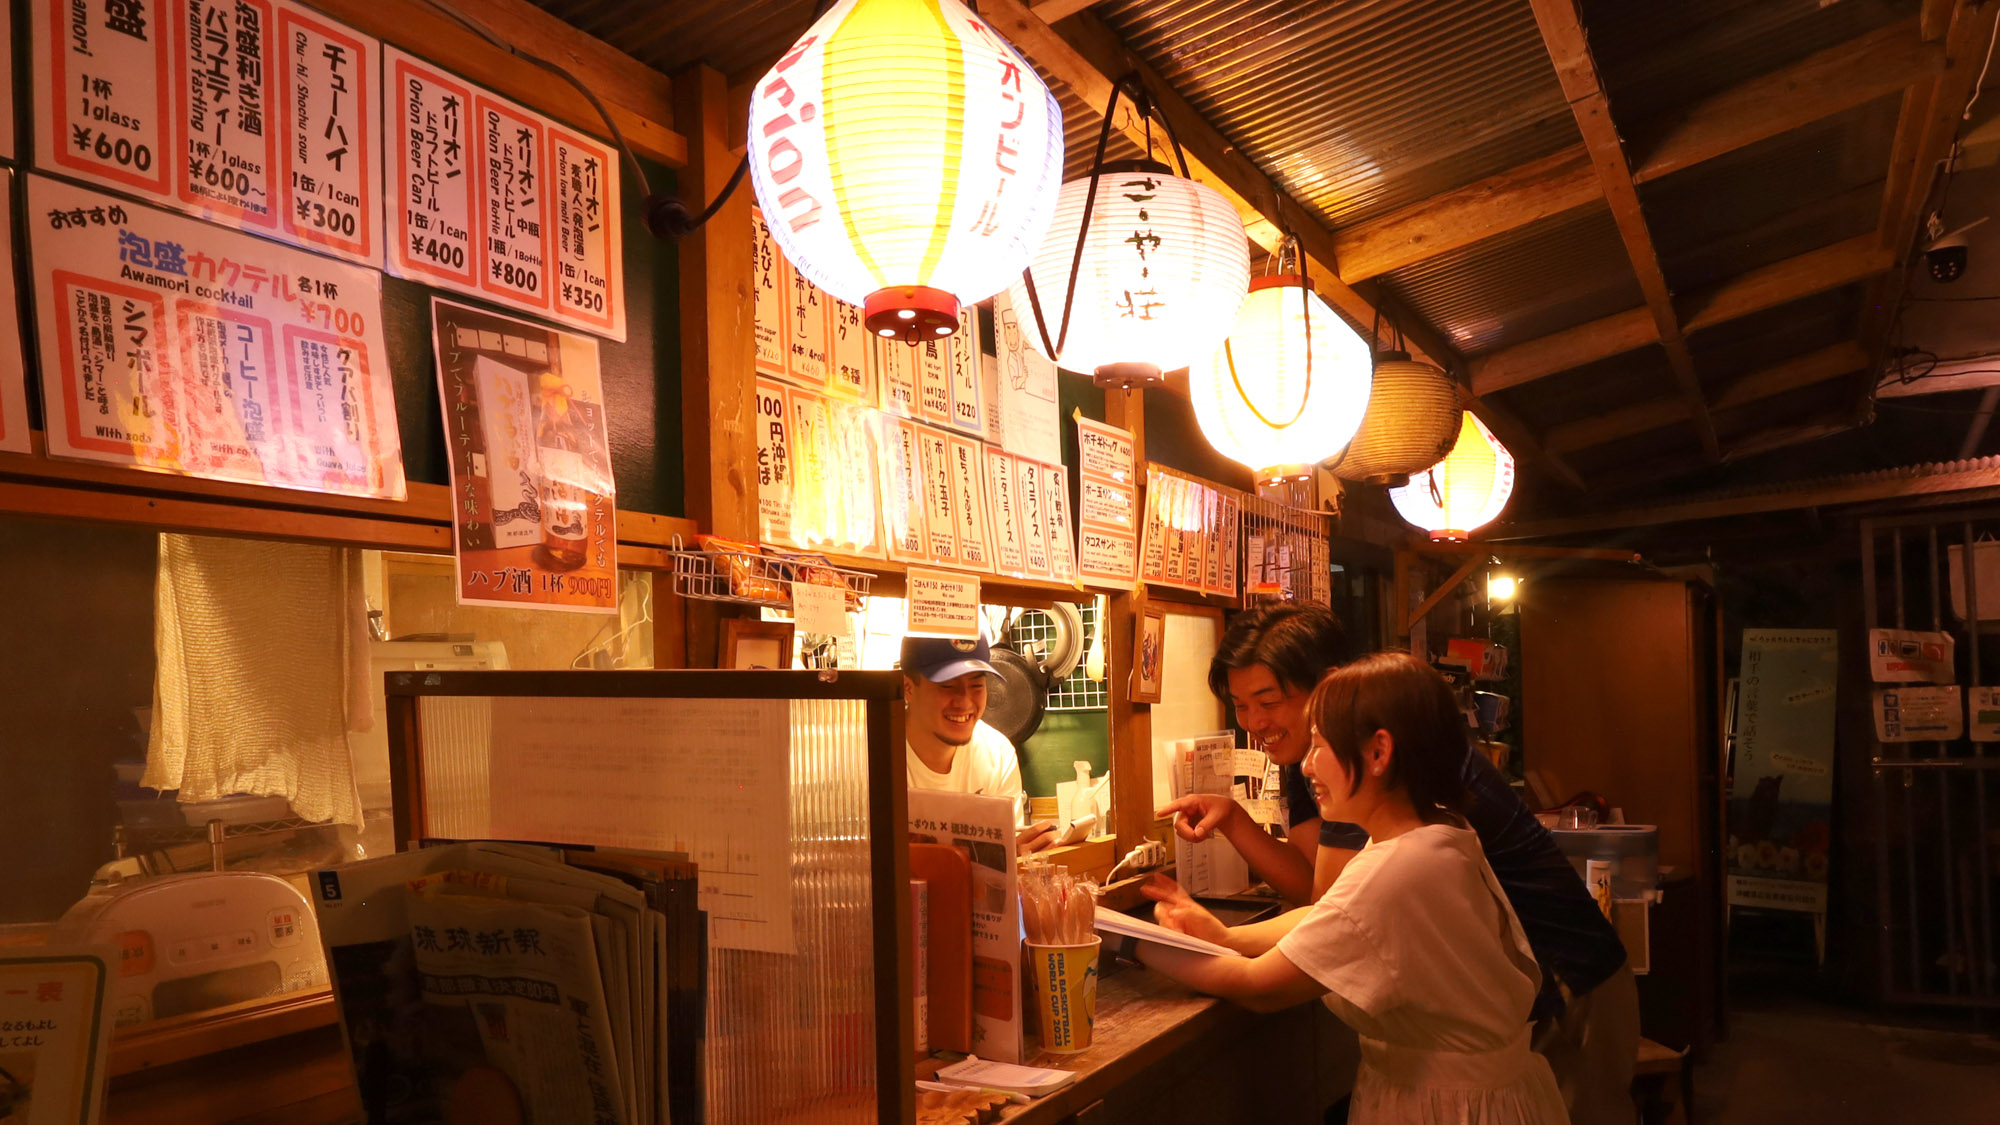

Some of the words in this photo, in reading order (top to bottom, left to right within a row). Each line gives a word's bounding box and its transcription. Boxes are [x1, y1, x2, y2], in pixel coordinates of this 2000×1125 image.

[81, 74, 113, 97] 1杯
[205, 6, 231, 146] バラエティー
[82, 98, 140, 132] 1glass
[190, 69, 207, 132] tasting
[322, 43, 349, 173] チューハイ
[409, 78, 423, 125] Orion
[72, 123, 152, 171] ¥600
[298, 132, 308, 164] sour
[410, 128, 424, 169] Beer
[442, 95, 462, 179] オリオン
[488, 110, 501, 154] Orion
[425, 111, 440, 213] ドラフトビール
[489, 157, 502, 196] Beer
[516, 128, 535, 207] オリオン
[558, 146, 567, 178] Orion
[411, 172, 425, 206] Can
[502, 143, 516, 239] ドラフトビール
[559, 180, 568, 199] low
[584, 157, 600, 233] オリオン
[48, 206, 127, 230] おすすめ
[296, 197, 356, 237] ¥300
[491, 199, 501, 236] Bottle
[516, 218, 541, 239] 中瓶
[411, 233, 464, 269] ¥400
[561, 229, 570, 253] Beer
[760, 222, 773, 289] ちんびん
[118, 229, 297, 302] 泡盛カクテル
[491, 258, 538, 292] ¥800
[121, 265, 189, 294] Awamori
[195, 285, 253, 309] cocktail
[298, 276, 338, 300] 各1杯
[562, 282, 603, 313] ¥350
[300, 300, 365, 336] ¥700
[122, 300, 156, 418] シマボール
[953, 336, 963, 377] アイス
[236, 324, 266, 443] コーヒー泡盛
[956, 401, 976, 419] ¥220
[126, 429, 152, 444] soda
[757, 446, 770, 486] そば
[934, 439, 950, 518] ポーク玉子
[999, 457, 1014, 543] ミニタコライス
[1027, 466, 1041, 538] タコライス
[935, 545, 951, 557] ¥700
[966, 551, 982, 562] ¥800
[1084, 535, 1117, 551] タコスサンド
[1030, 555, 1046, 569] ¥400
[468, 567, 532, 595] ハブ酒
[569, 576, 612, 598] 900円
[325, 884, 338, 898] 5
[413, 924, 546, 957] 琉球新報
[1048, 953, 1057, 992] WORLD
[1057, 952, 1065, 976] FIBA
[1051, 993, 1059, 1018] CUP
[1058, 979, 1072, 1047] BASKETBALL
[1053, 1020, 1062, 1047] 2023
